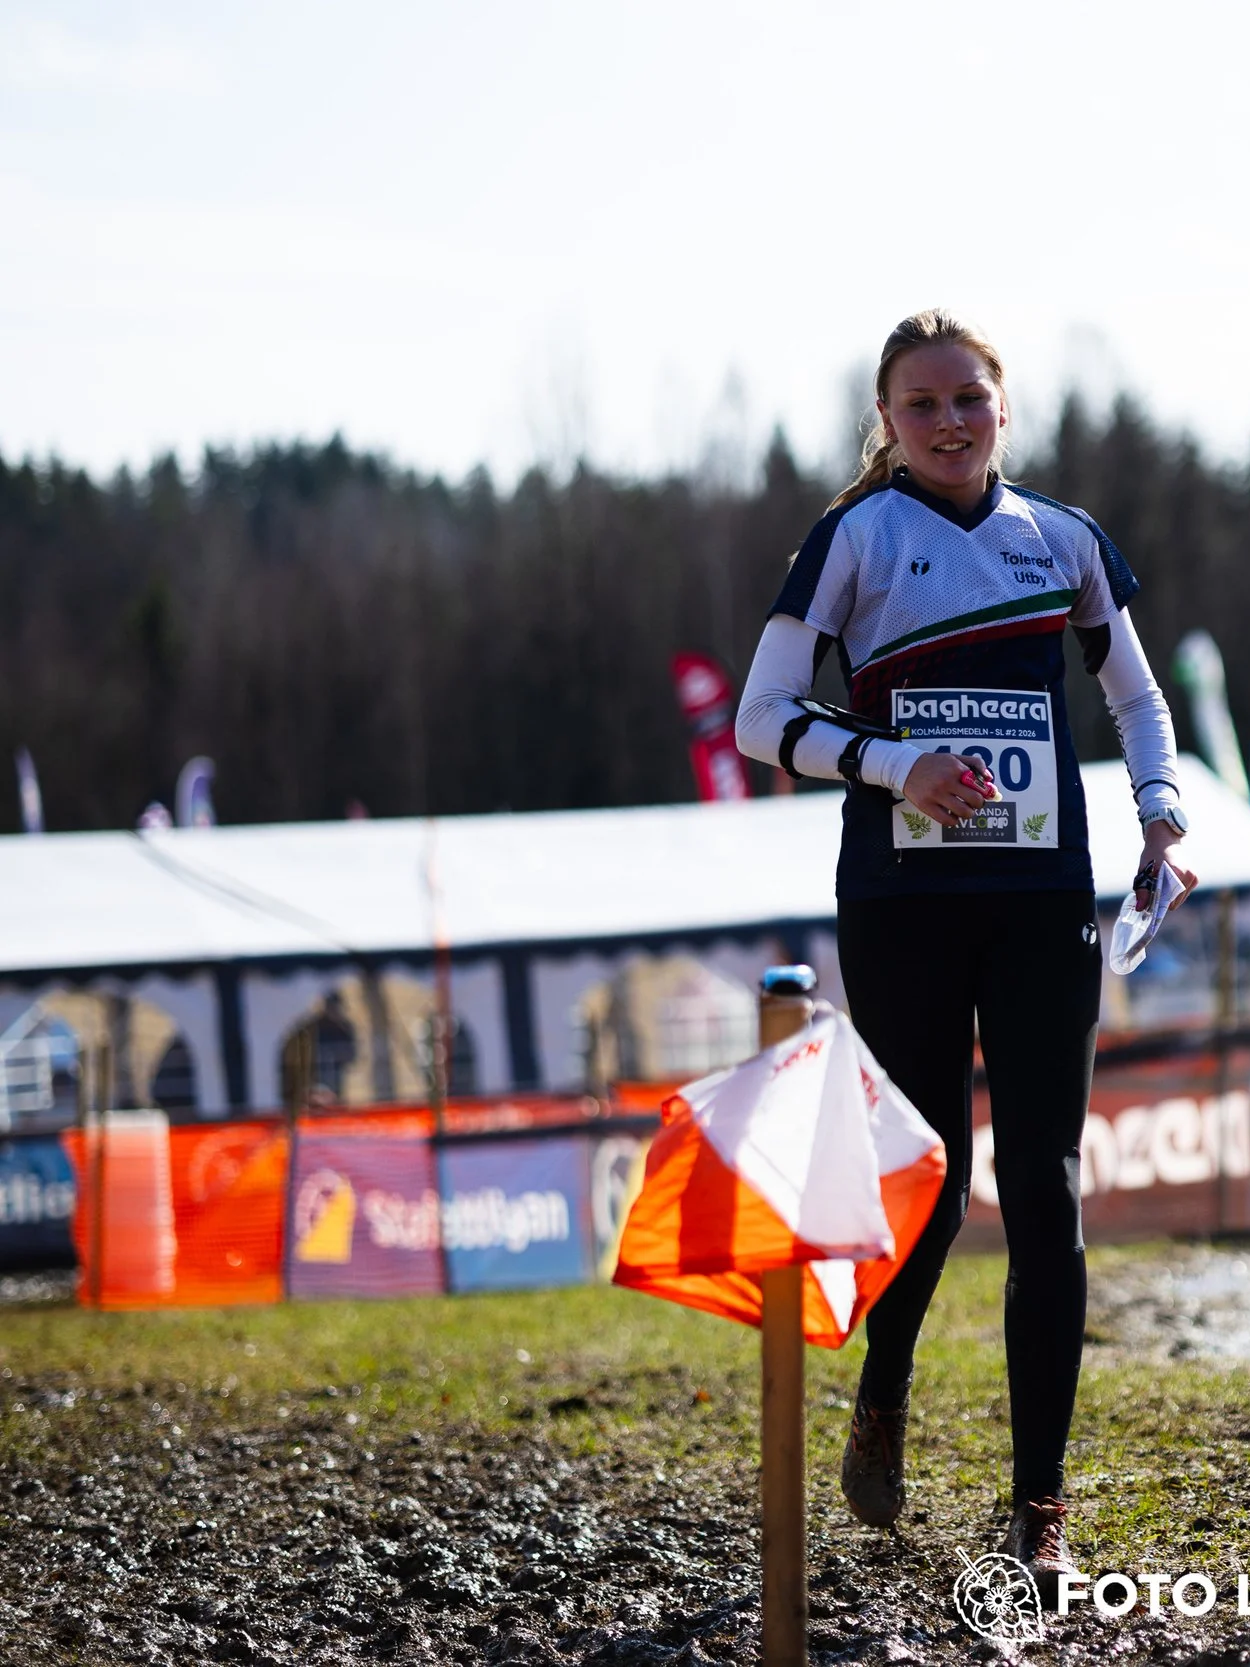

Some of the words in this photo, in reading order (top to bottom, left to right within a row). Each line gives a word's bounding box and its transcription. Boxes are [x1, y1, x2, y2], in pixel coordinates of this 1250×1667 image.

[1001, 551, 1054, 569] Tolered
[1013, 571, 1047, 588] Utby
[897, 694, 1047, 722] bagheera
[911, 725, 989, 736] KOLMÅRDSMEDELN
[995, 728, 1005, 736] SL
[1005, 728, 1017, 736] #2
[1018, 729, 1036, 738] 2026
